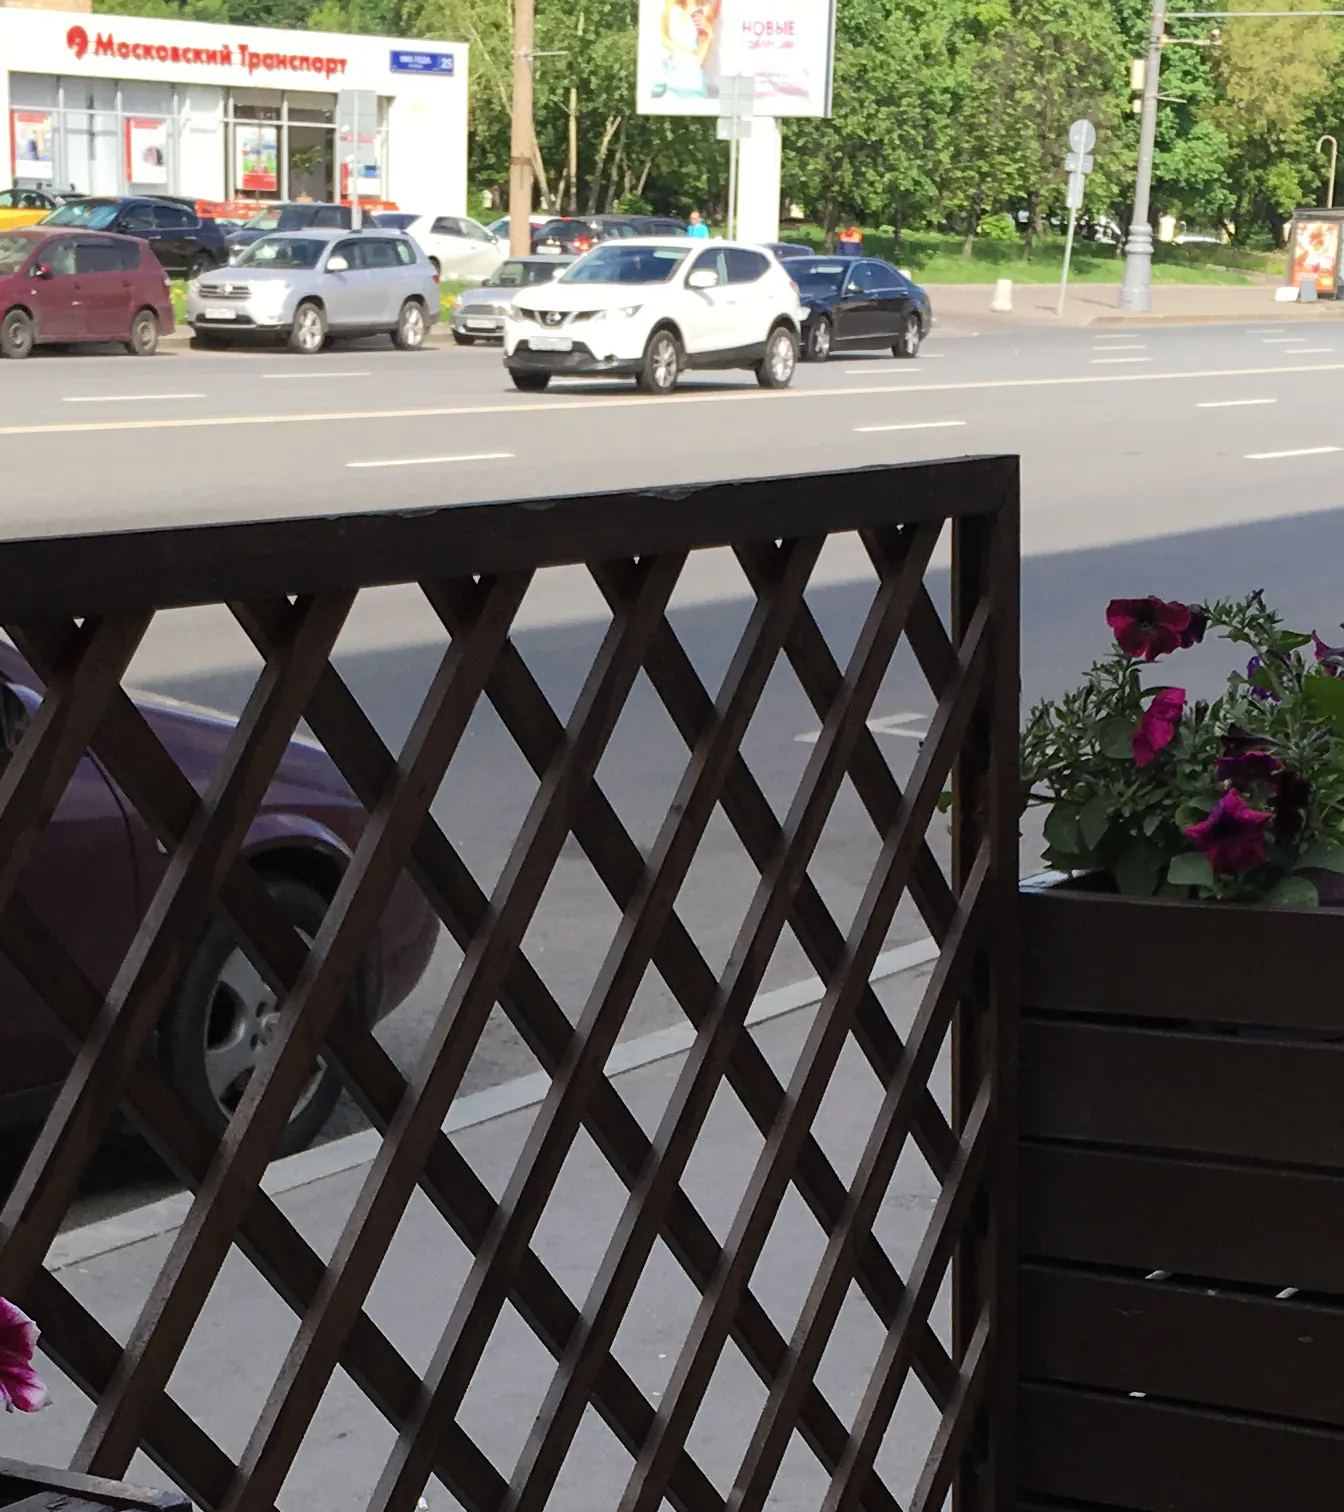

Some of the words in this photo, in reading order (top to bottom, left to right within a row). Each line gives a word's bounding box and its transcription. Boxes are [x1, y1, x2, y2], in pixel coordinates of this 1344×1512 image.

[742, 20, 795, 36] НОВЫЕ
[94, 32, 232, 66] Московский
[238, 43, 348, 80] Транспорт
